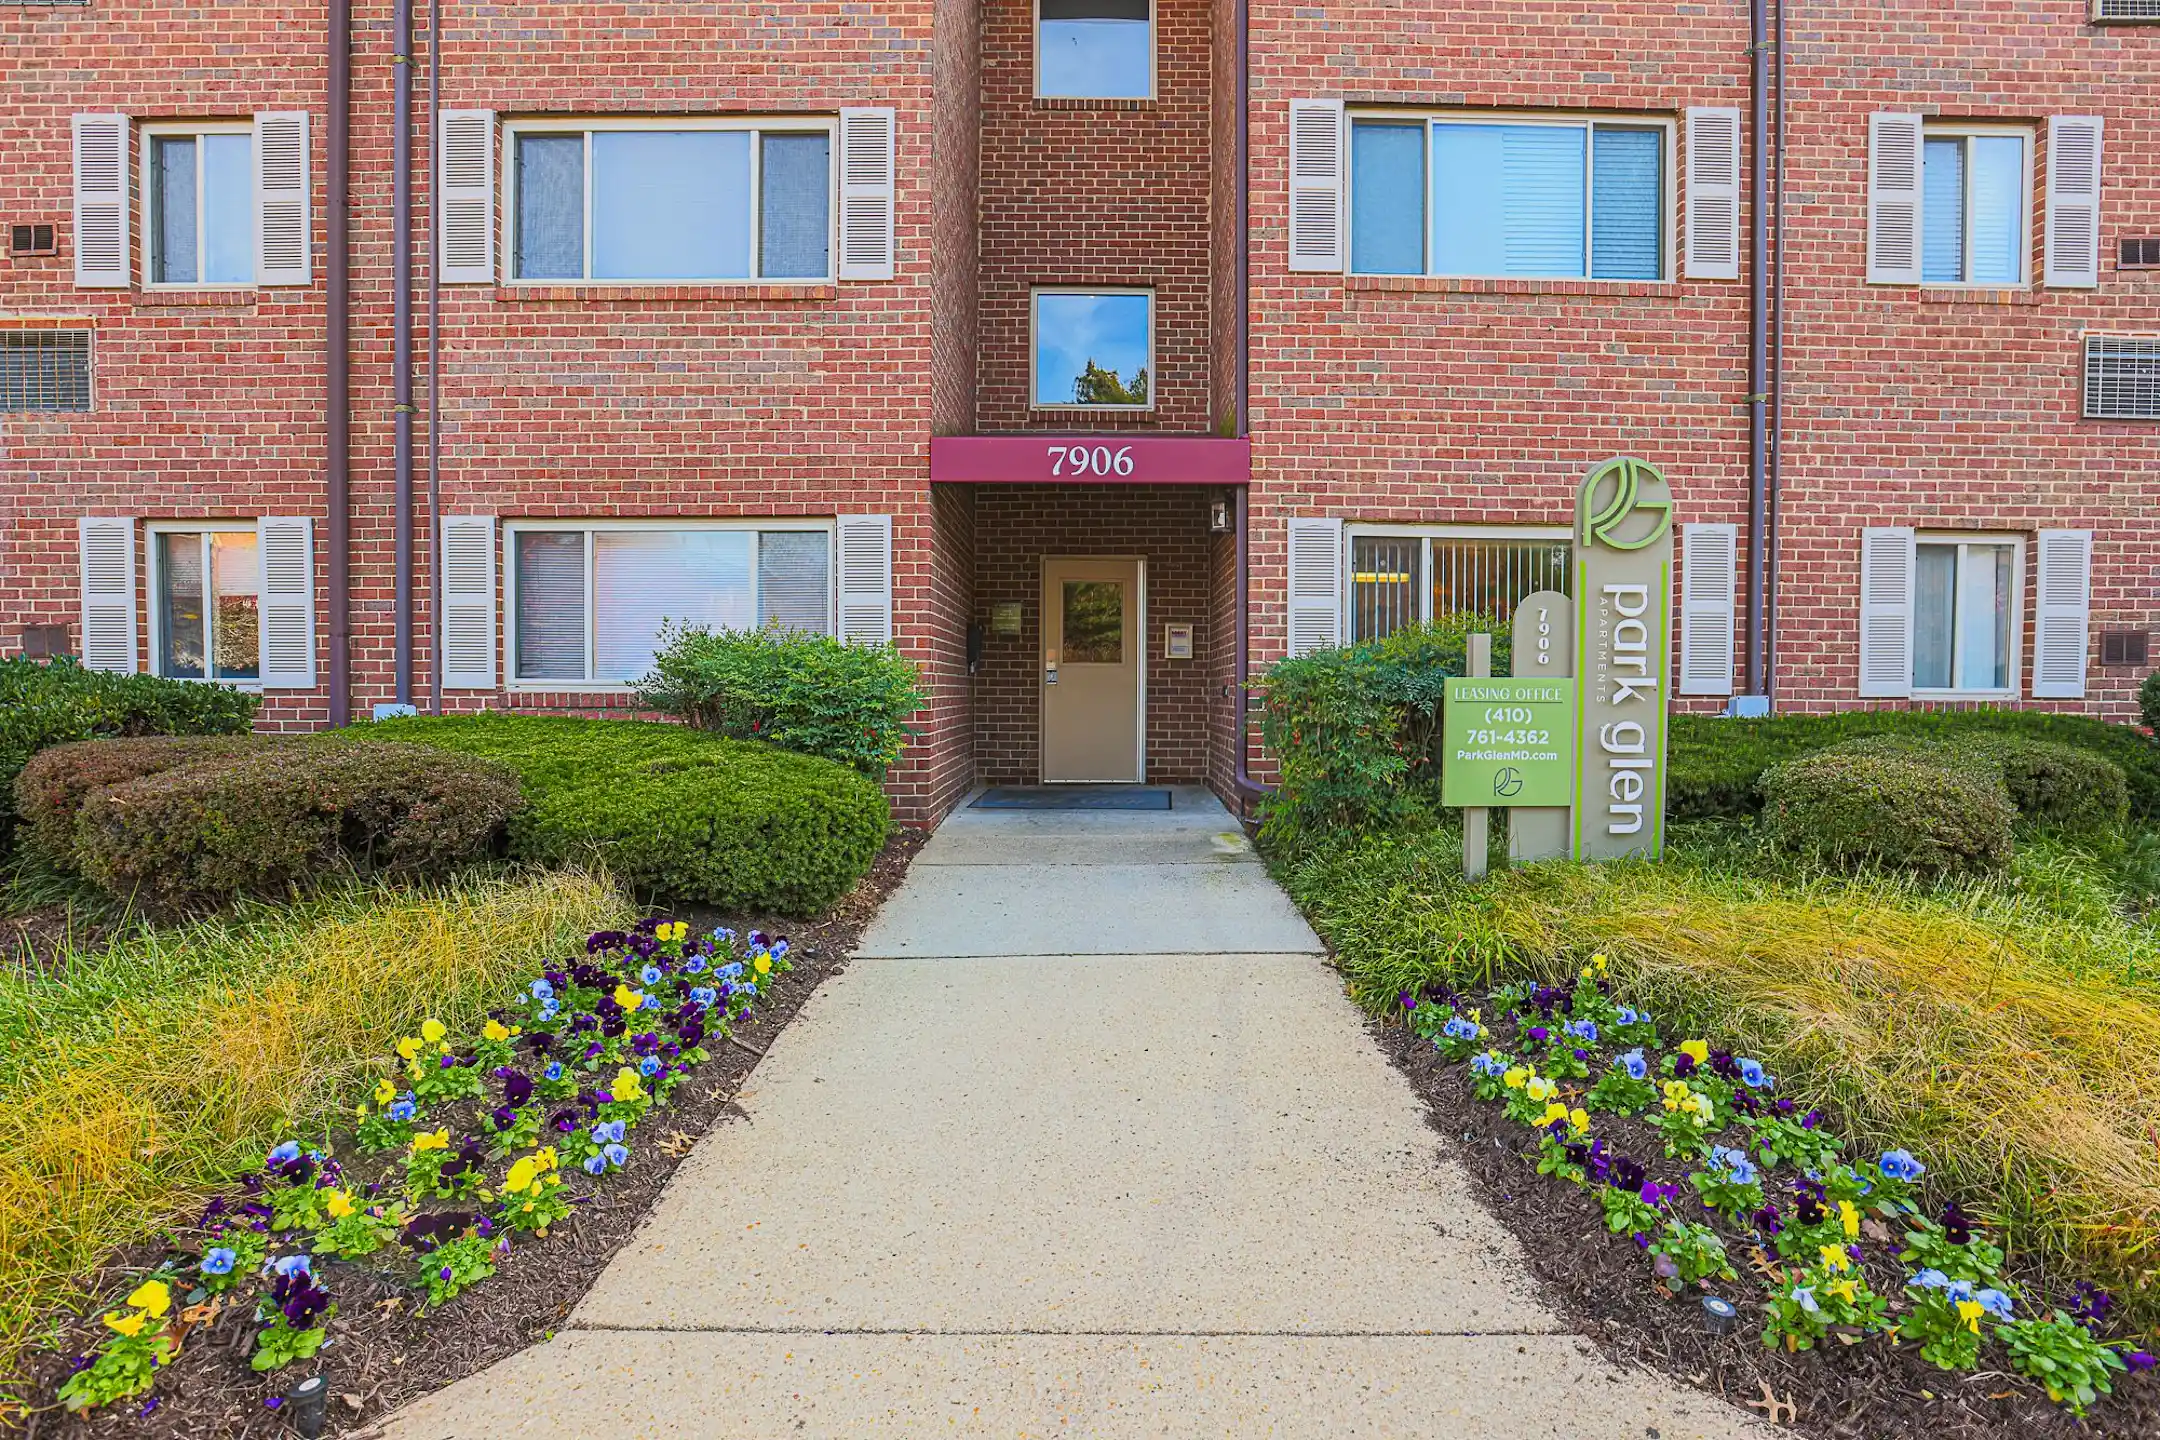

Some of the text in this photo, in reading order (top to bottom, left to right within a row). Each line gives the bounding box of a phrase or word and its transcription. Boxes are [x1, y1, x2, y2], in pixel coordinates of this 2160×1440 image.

[1047, 445, 1134, 476] 7906
[1537, 607, 1551, 665] 7906
[1596, 597, 1609, 703] APARTMENTS
[1455, 687, 1563, 701] LEASING OFFICE
[1485, 707, 1533, 725] (410)
[1600, 584, 1658, 834] park glen
[1467, 729, 1550, 745] 761-4362
[1457, 750, 1558, 761] ParkGlenMD.com
